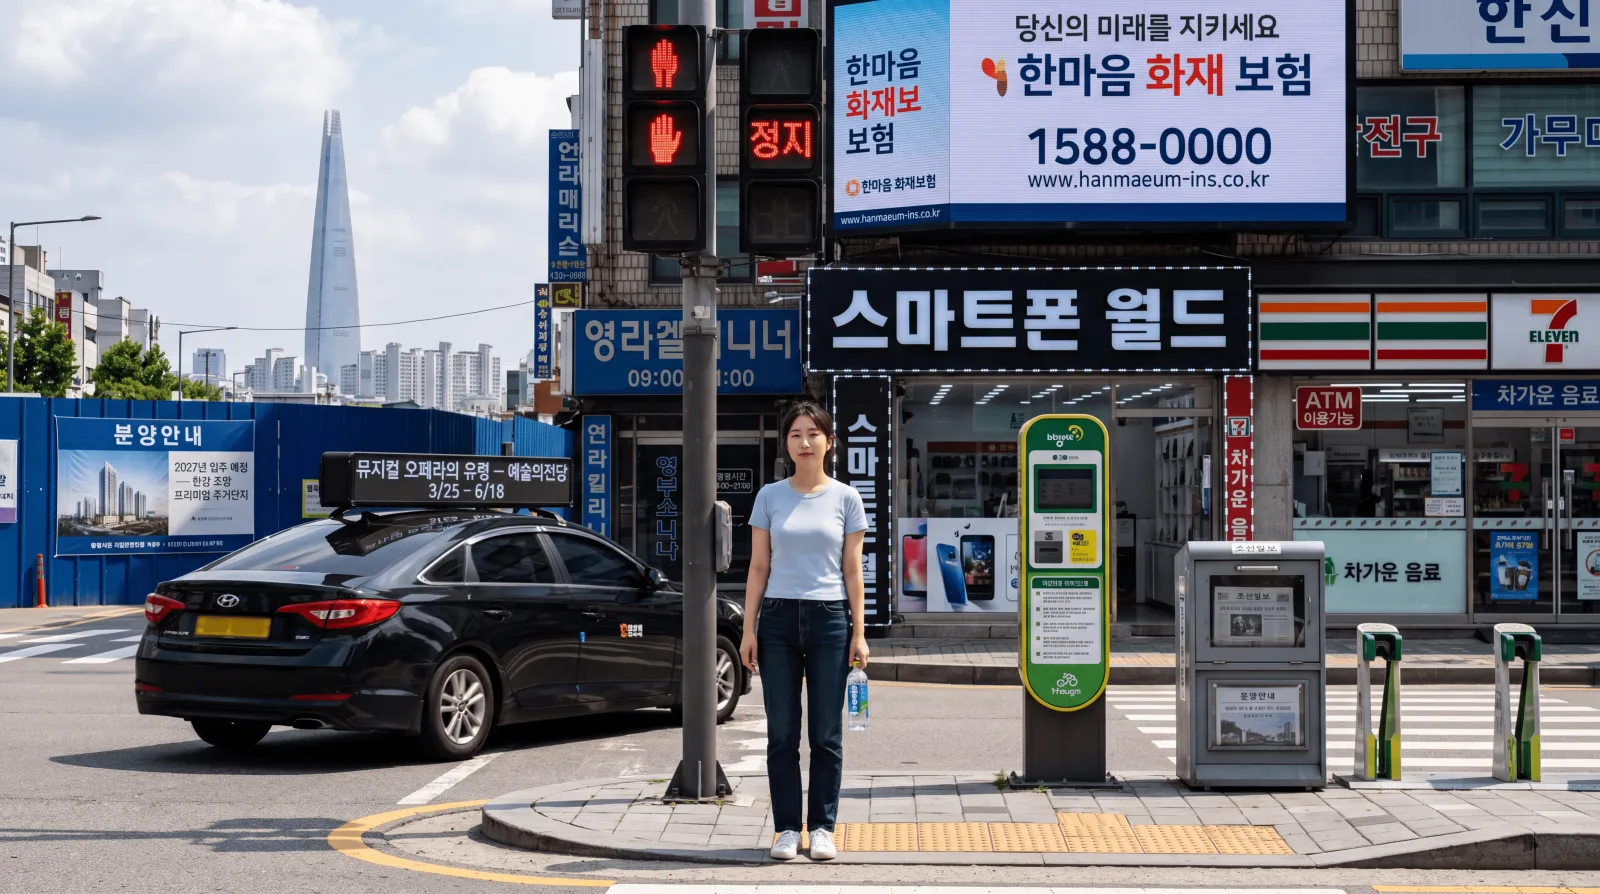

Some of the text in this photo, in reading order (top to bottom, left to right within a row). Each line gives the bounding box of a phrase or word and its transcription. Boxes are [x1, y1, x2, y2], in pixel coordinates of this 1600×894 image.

[1014, 13, 1280, 42] 당신의 미래를 지키세요
[846, 47, 922, 87] 한마음
[1018, 53, 1311, 97] 한마음 화재 보험
[846, 85, 922, 121] 화재보
[750, 120, 811, 158] 정지
[846, 122, 894, 154] 보험
[1028, 127, 1272, 166] 1588-0000
[1356, 114, 1442, 158] 전구
[861, 173, 936, 194] 한마음 화재보험
[1027, 170, 1271, 190] www.hanmaeum-ins.co.kr
[840, 207, 941, 225] www.hanmaeum-ins.co.kr
[832, 288, 1227, 351] 스마트폰 월드
[1305, 391, 1353, 409] ATM
[1497, 385, 1600, 406] 차가운 음료
[1303, 411, 1354, 426] 이용가능
[114, 424, 202, 447] 분양안내
[174, 462, 248, 473] 2027년 입주 예정
[356, 460, 399, 479] 뮤지컬
[404, 460, 459, 480] 오페라의
[463, 462, 490, 481] 유령
[507, 463, 568, 482] 예술의전당
[192, 476, 212, 487] 한강
[213, 476, 232, 487] 조망
[428, 483, 460, 500] 3/25
[474, 483, 505, 500] 6/18
[174, 490, 249, 501] 프리미엄 주거단지
[1231, 449, 1249, 541] 차가운 음
[1344, 562, 1442, 582] 차가운 음료
